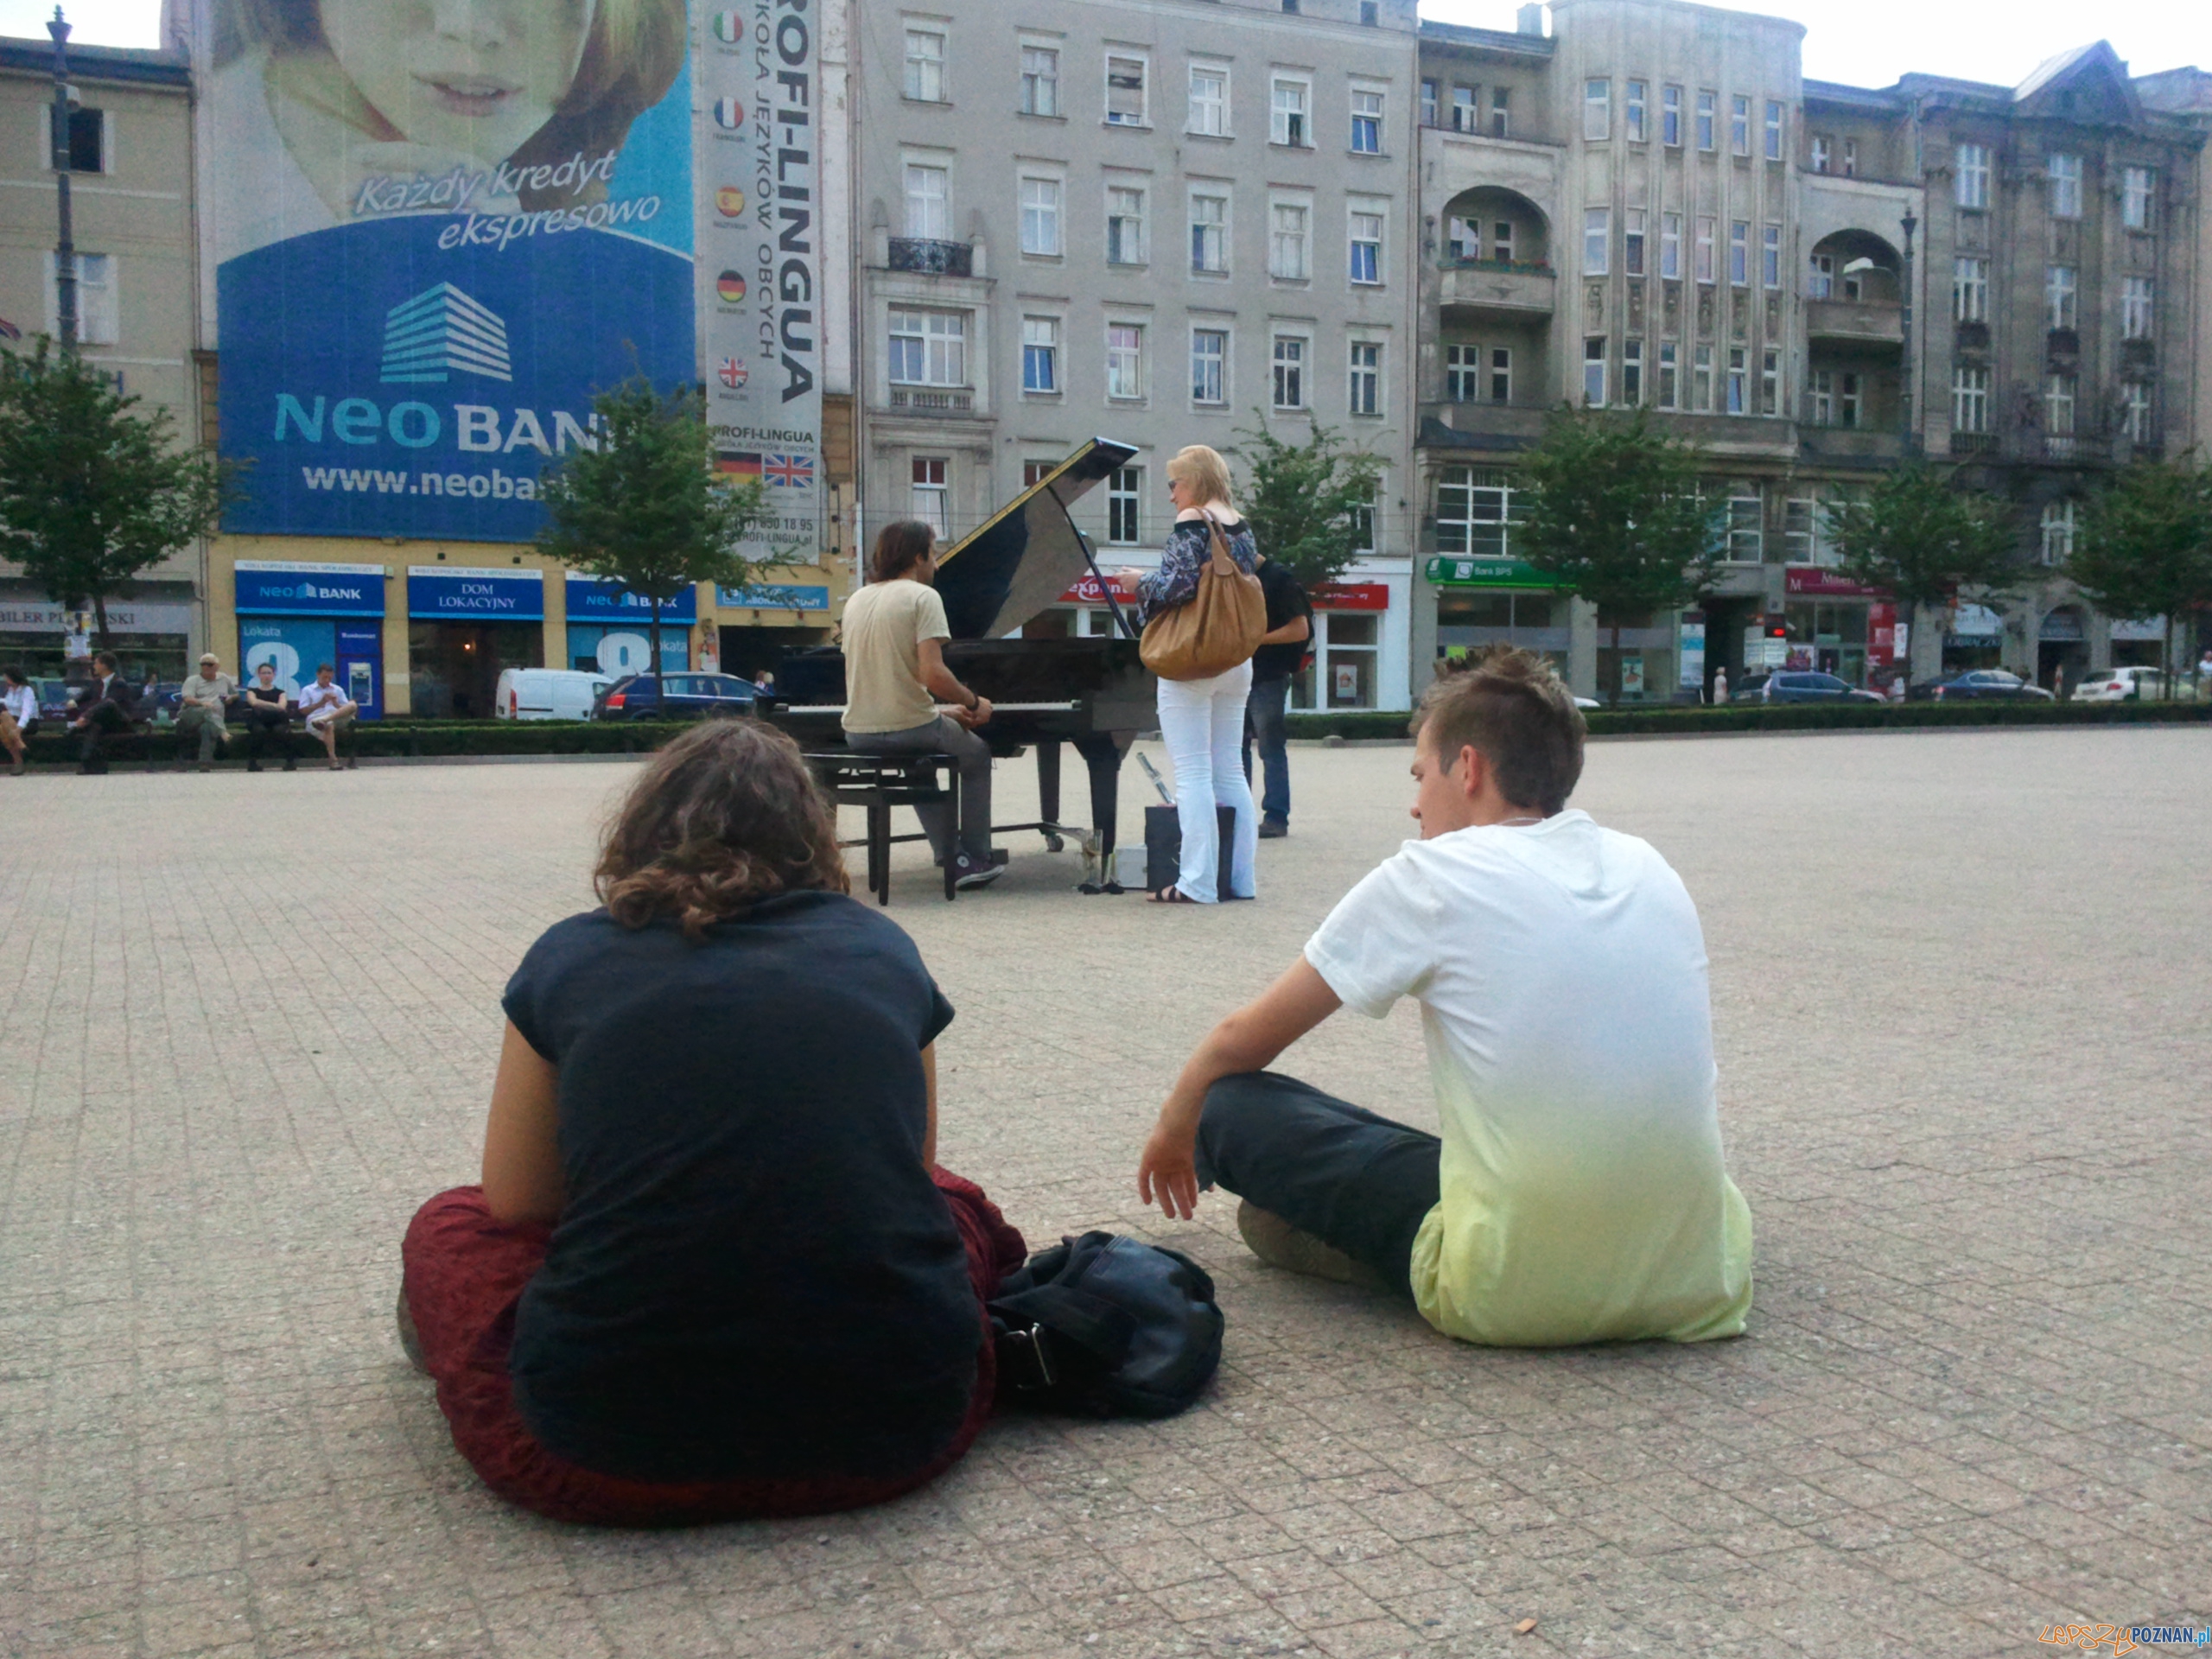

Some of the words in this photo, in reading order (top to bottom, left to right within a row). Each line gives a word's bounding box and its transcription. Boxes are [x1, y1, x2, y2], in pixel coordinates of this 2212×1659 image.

[755, 0, 770, 80] KOŁA
[753, 90, 774, 230] JĘZYKÓW
[356, 169, 482, 213] Każdy
[492, 149, 618, 195] kredyt
[777, 0, 814, 404] OFI-LINGUA
[438, 195, 661, 252] ekspresowo
[758, 243, 774, 359] OBCYCH
[275, 393, 441, 448] Neo
[454, 404, 615, 456] BAN
[713, 424, 814, 443] PROFI-LINGUA
[302, 466, 576, 501] www.neoba
[784, 518, 796, 531] 18
[799, 518, 813, 531] 95
[461, 583, 493, 595] DOM
[1474, 566, 1494, 576] Bank
[1496, 567, 1512, 577] BPS
[319, 588, 361, 600] BANK
[438, 596, 516, 610] LOKACYJNY
[243, 625, 282, 638] Lokata
